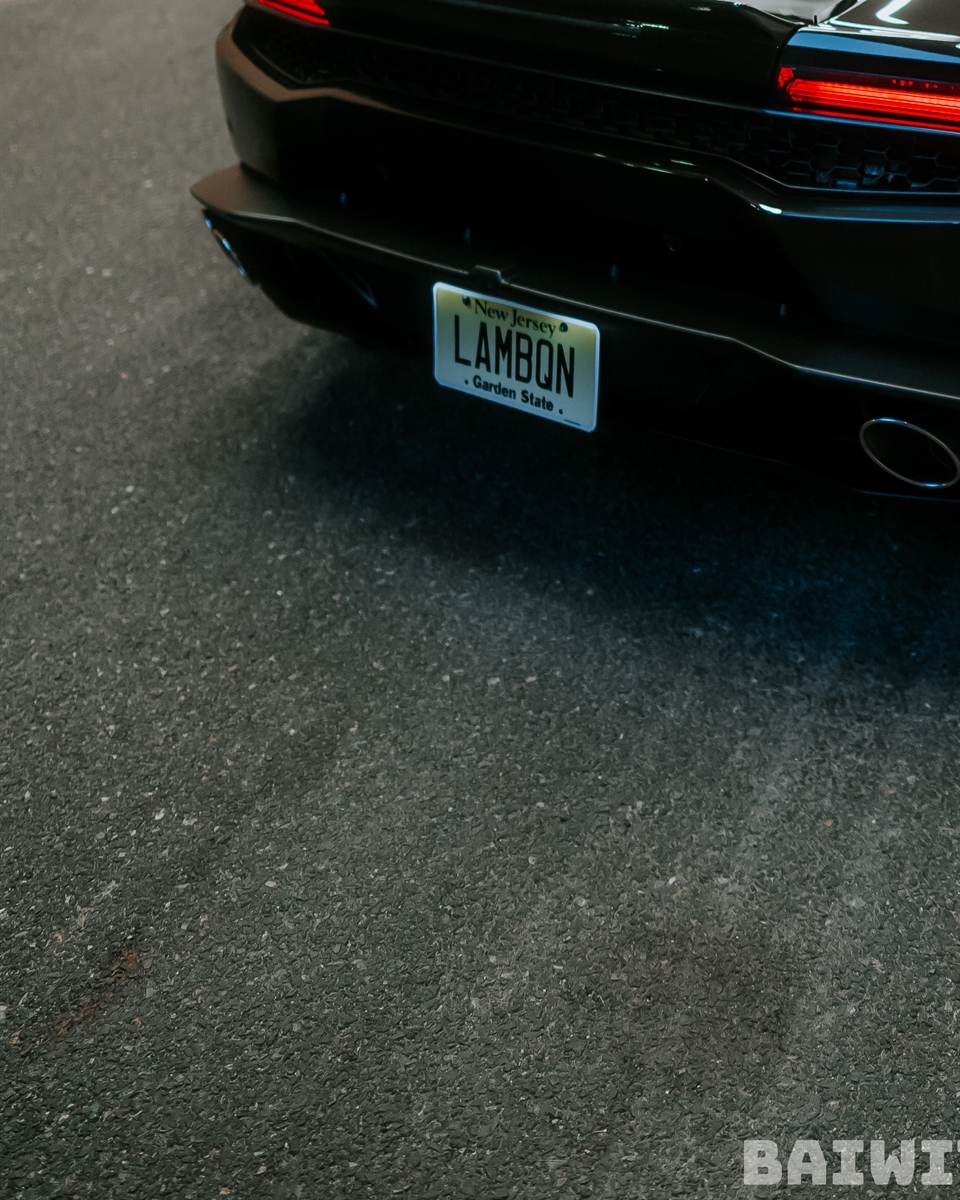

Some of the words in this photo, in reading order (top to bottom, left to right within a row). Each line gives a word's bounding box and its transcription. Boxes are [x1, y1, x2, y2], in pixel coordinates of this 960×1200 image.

[474, 298, 510, 321] New
[510, 308, 557, 338] Jersey
[454, 314, 575, 399] LAMBQN
[472, 374, 517, 401] Garden
[521, 389, 555, 412] State
